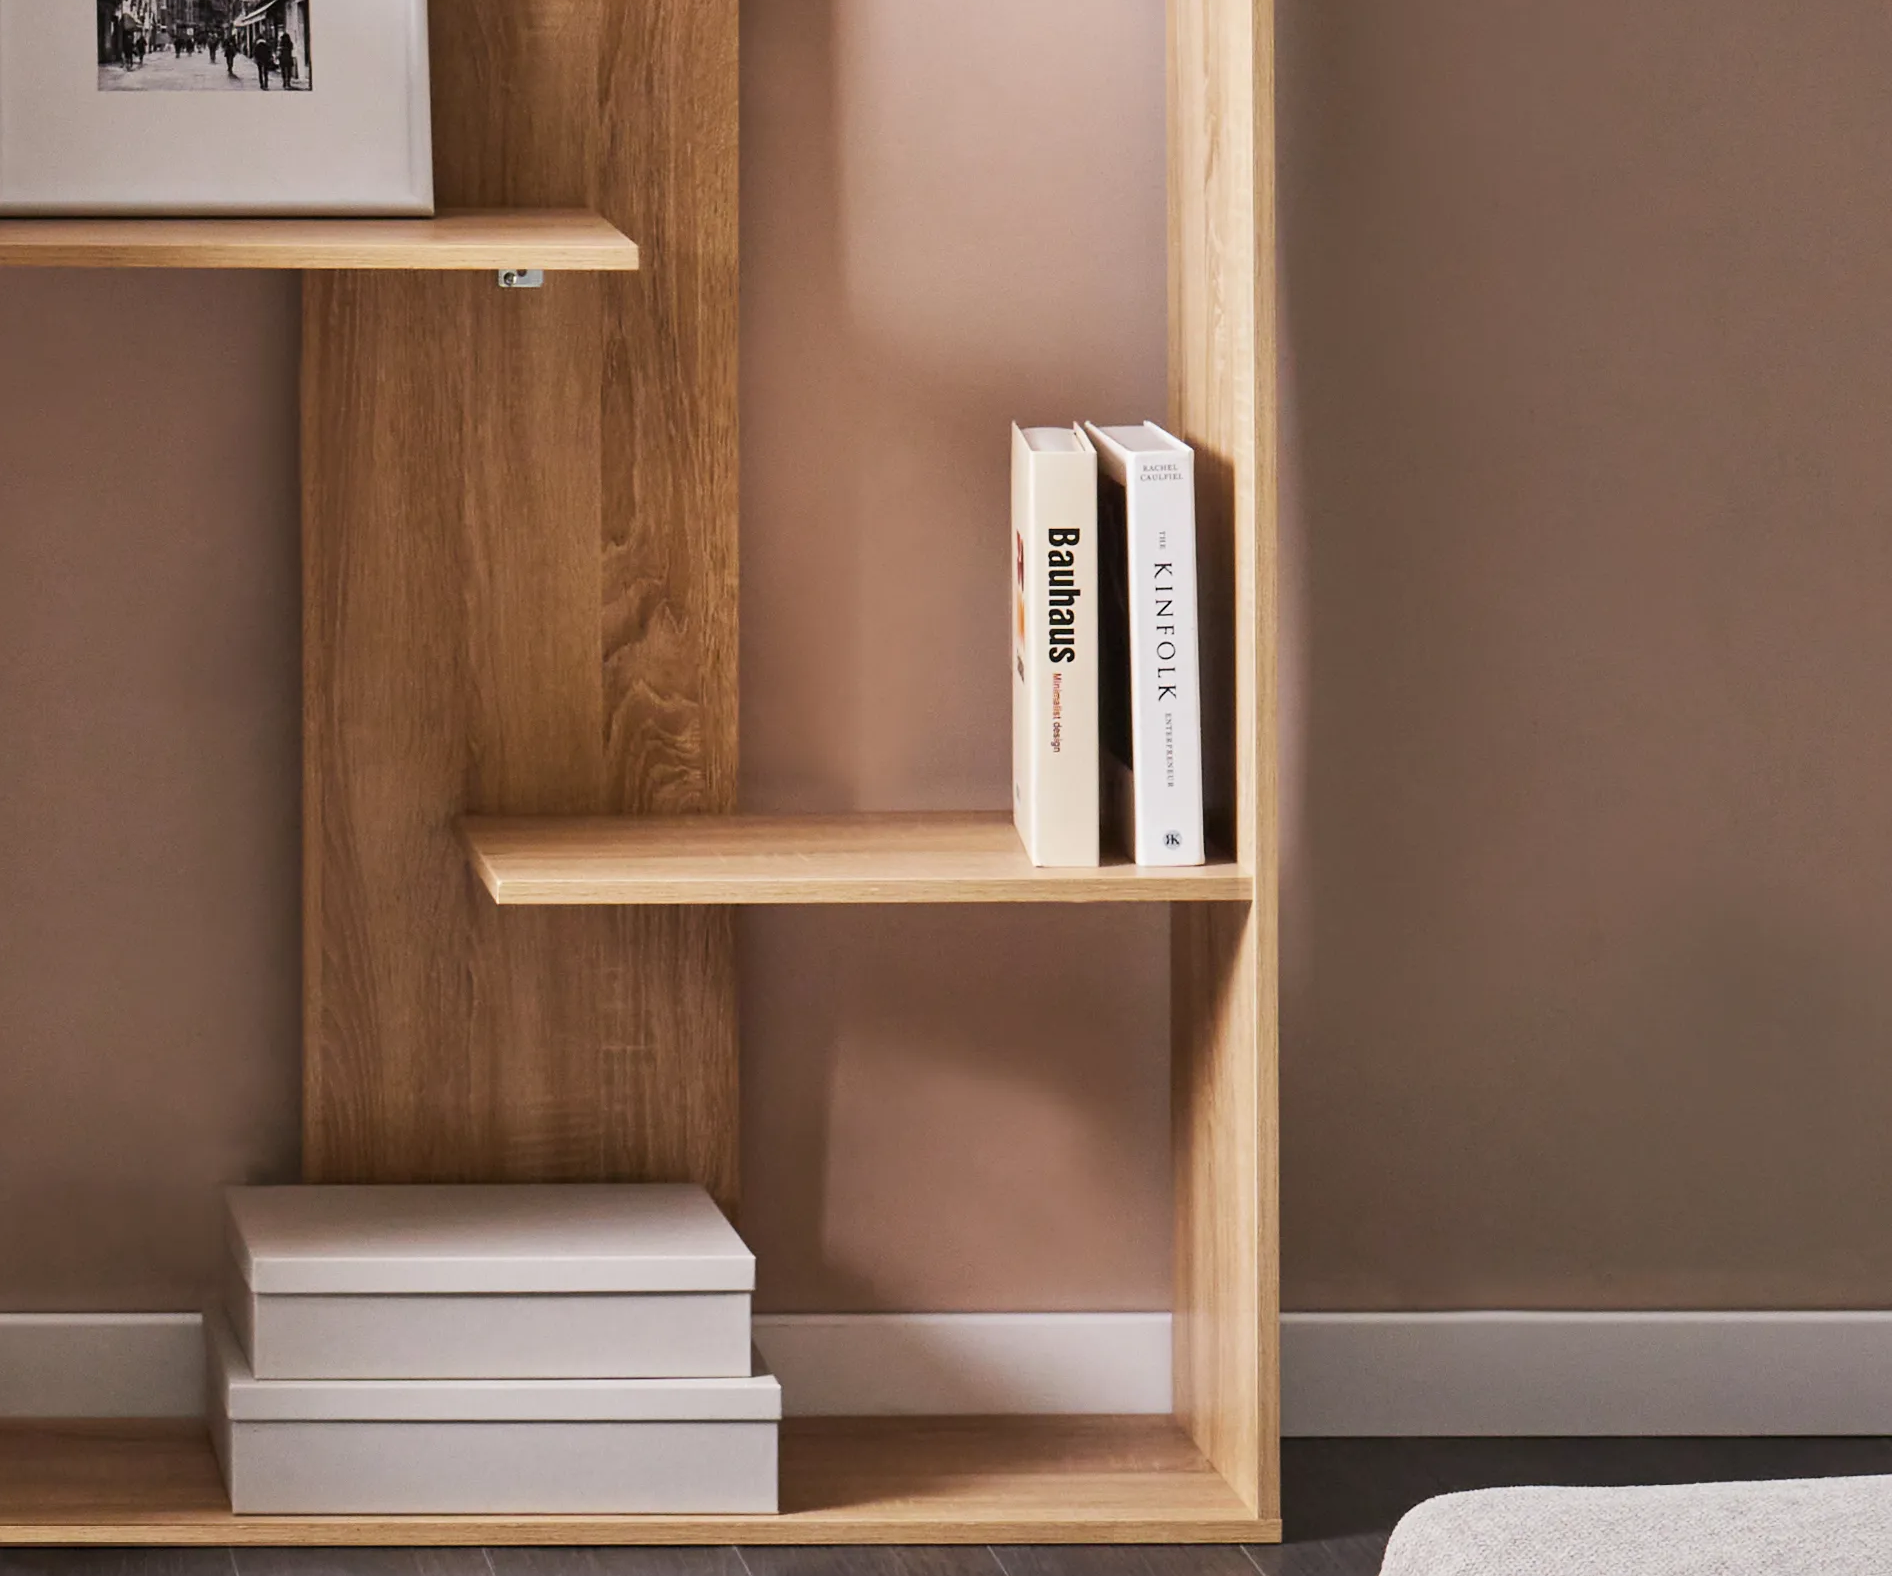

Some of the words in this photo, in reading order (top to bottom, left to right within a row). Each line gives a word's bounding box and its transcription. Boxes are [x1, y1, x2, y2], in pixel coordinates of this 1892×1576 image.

[1142, 464, 1178, 472] RACHEL
[1159, 531, 1167, 550] THE
[1047, 527, 1081, 663] Bauhaus
[1154, 562, 1177, 702] KINFOLK
[1052, 672, 1063, 720] Minimalist
[1050, 721, 1063, 753] design
